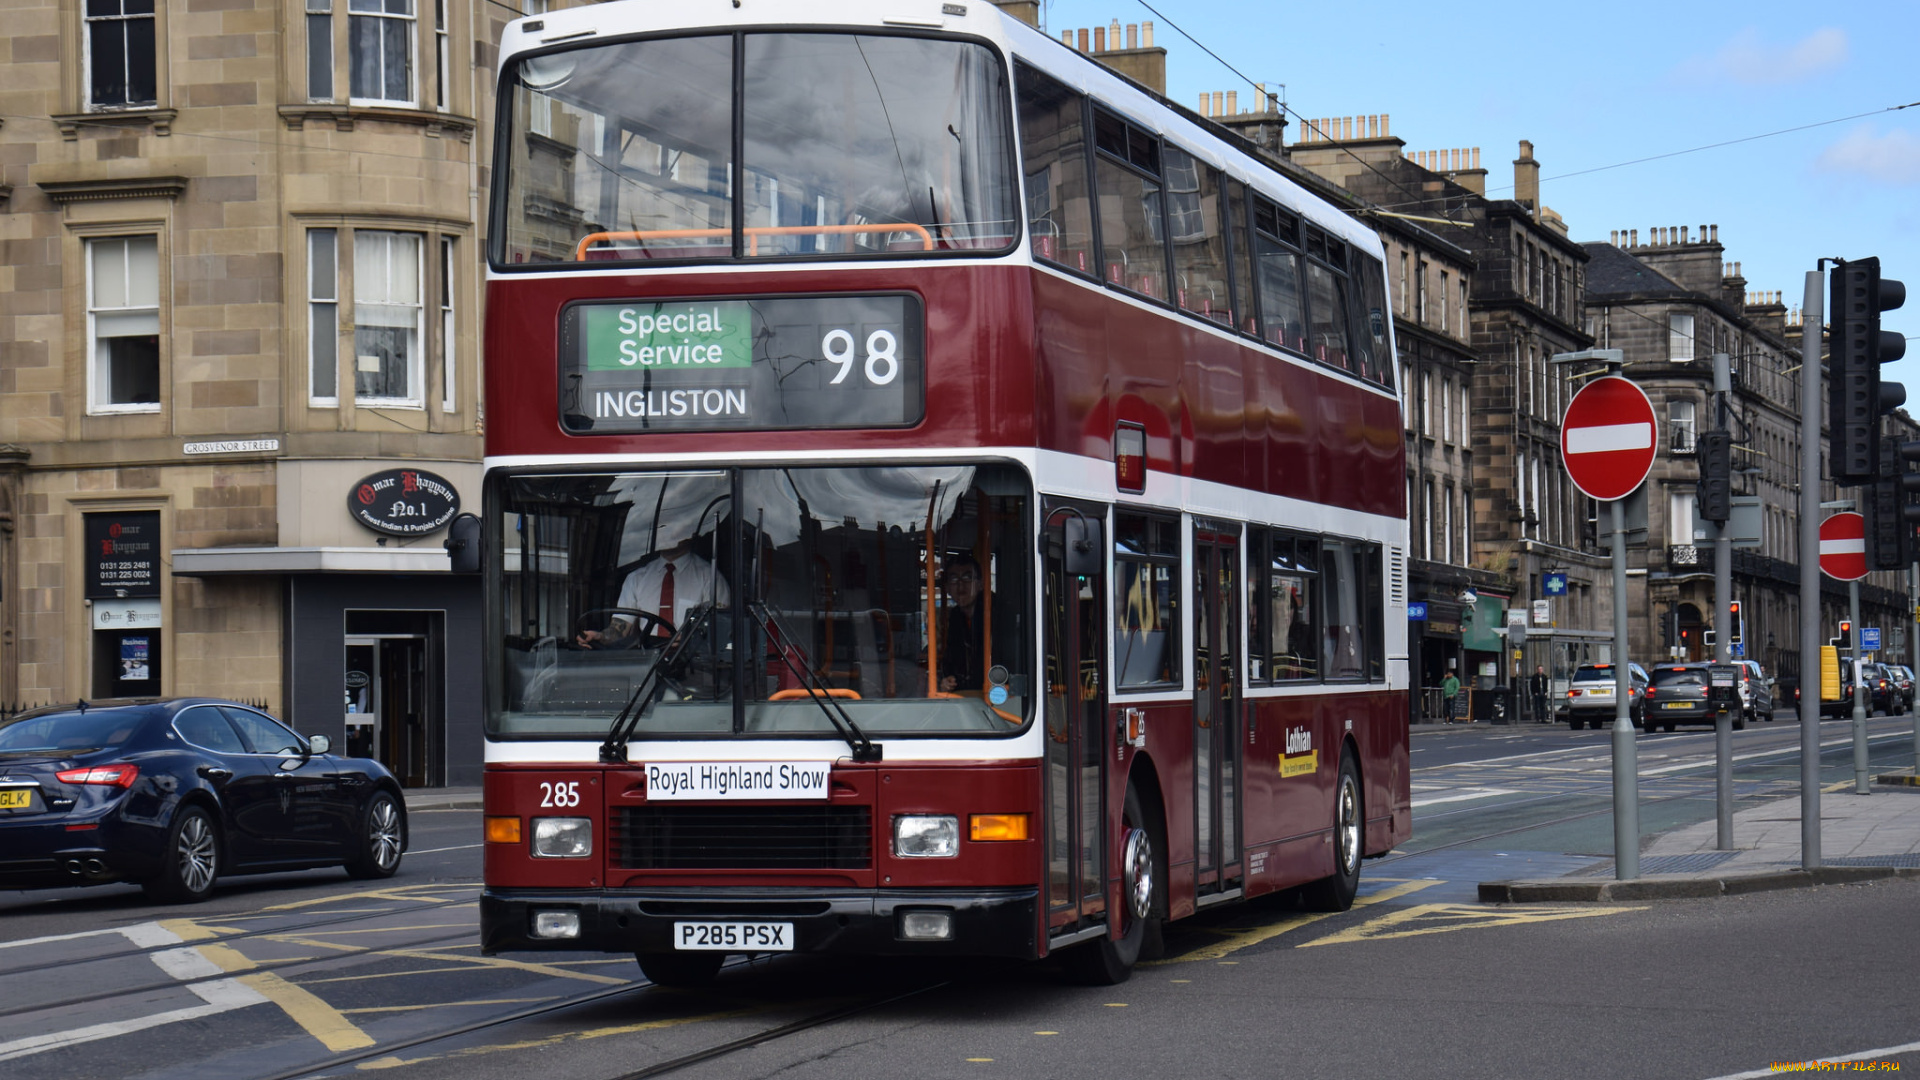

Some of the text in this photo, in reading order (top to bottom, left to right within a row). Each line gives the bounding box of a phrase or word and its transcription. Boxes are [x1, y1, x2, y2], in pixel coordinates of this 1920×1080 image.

[618, 307, 722, 338] Special
[618, 338, 722, 366] Service
[821, 329, 898, 385] 98
[595, 388, 746, 418] INGLISTON
[186, 440, 275, 453] GROSVENOR STREET
[357, 471, 454, 505] Omar Khayyam
[109, 523, 140, 538] Omar
[360, 506, 455, 532] Finest Indian & Punjabi Cuisine
[101, 539, 150, 559] Khayyam
[100, 571, 117, 579] 0131
[133, 570, 150, 578] 0024
[133, 561, 150, 569] 2481
[1141, 567, 1169, 581] HLL
[1286, 725, 1311, 754] Lothian
[650, 765, 824, 795] Royal Highland Show
[0, 792, 25, 805] GLK
[540, 781, 580, 807] 285
[682, 925, 783, 945] P285 PSX
